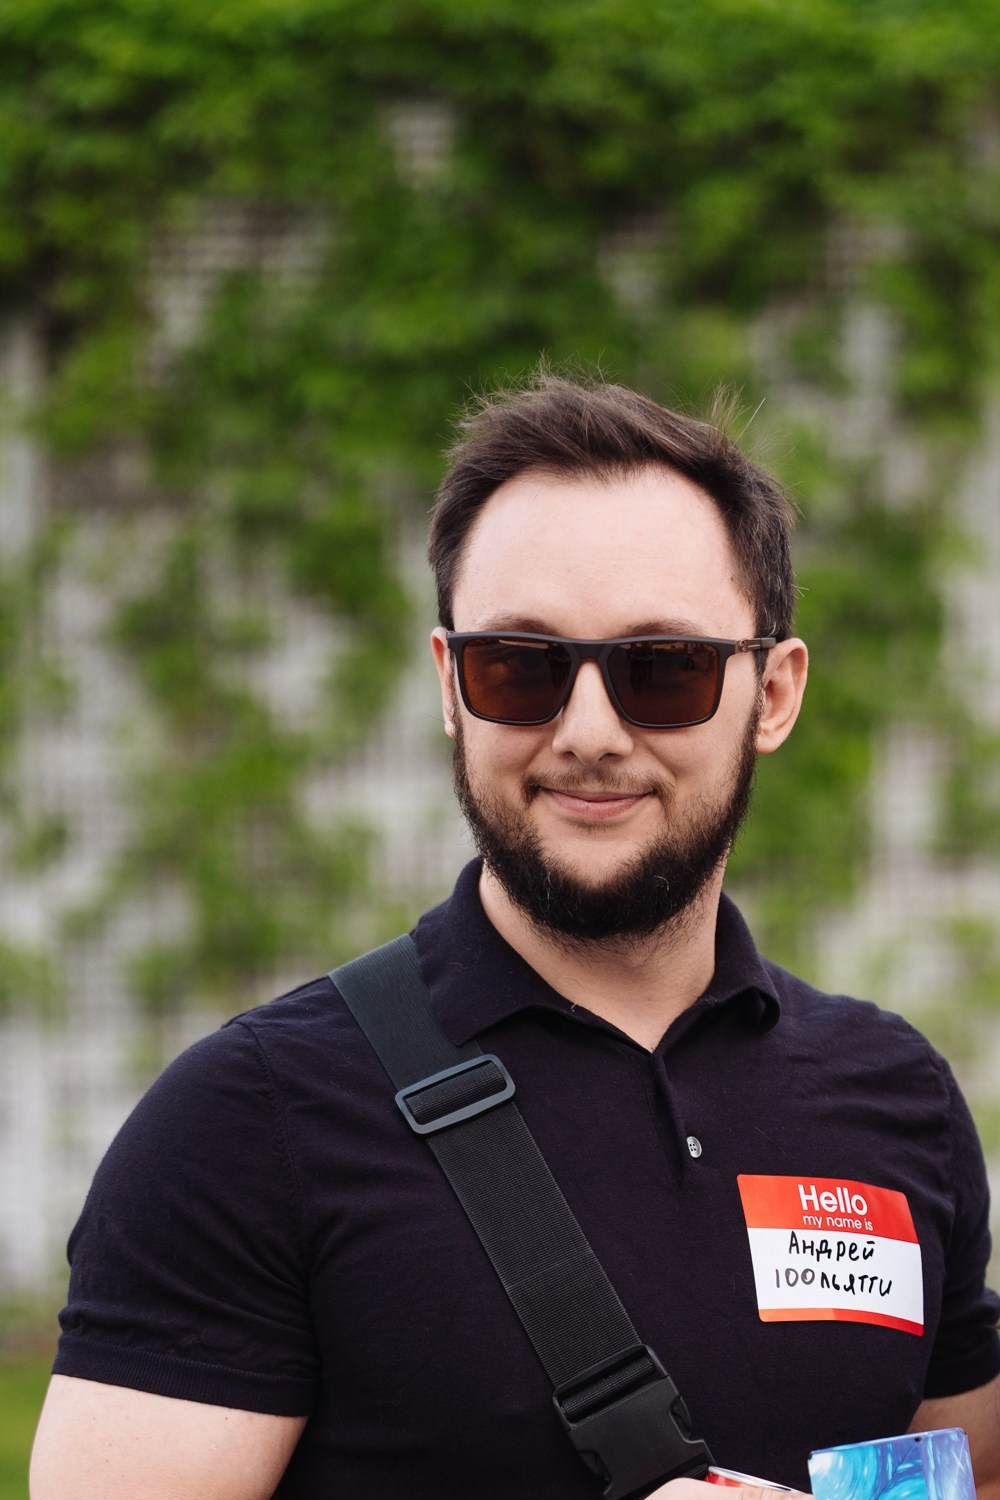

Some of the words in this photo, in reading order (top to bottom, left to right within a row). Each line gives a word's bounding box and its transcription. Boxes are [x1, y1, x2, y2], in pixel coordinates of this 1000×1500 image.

[798, 1184, 868, 1216] Hello
[803, 1214, 823, 1228] my
[826, 1216, 862, 1229] name
[864, 1218, 874, 1231] is
[788, 1230, 876, 1262] Андрей
